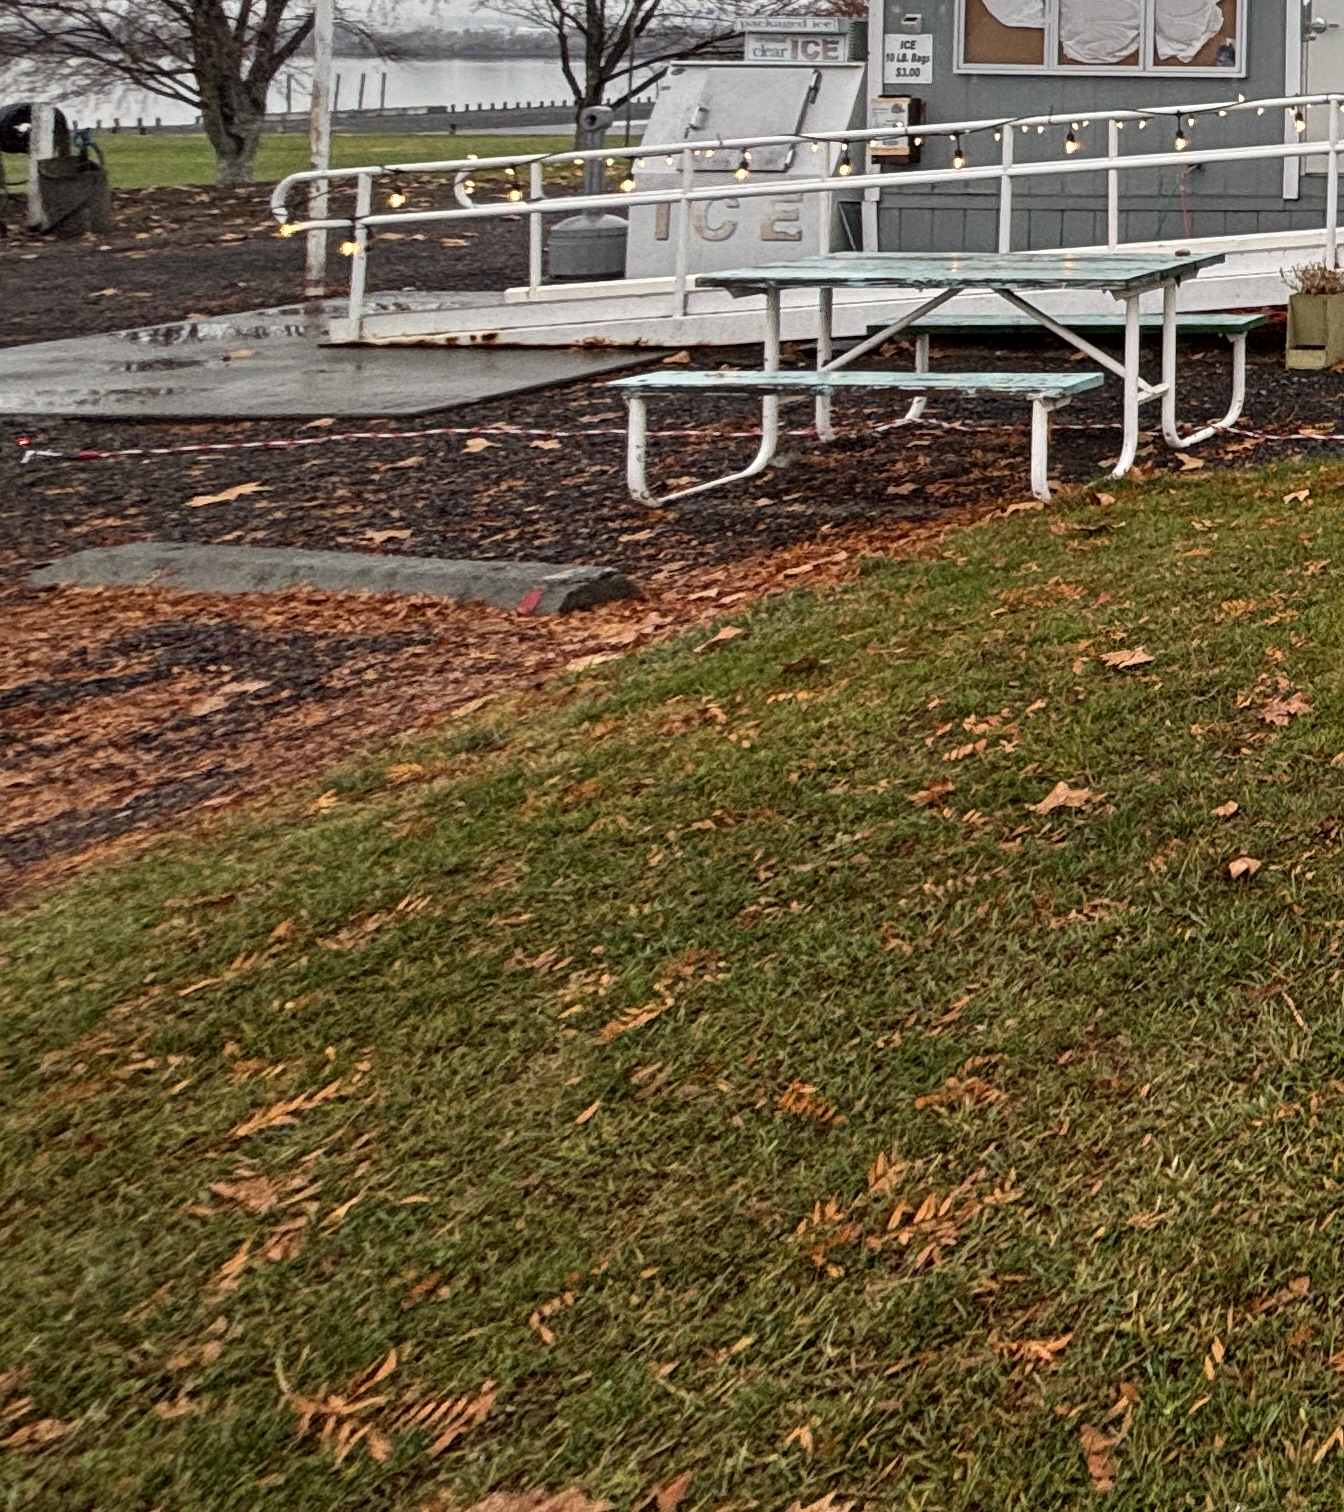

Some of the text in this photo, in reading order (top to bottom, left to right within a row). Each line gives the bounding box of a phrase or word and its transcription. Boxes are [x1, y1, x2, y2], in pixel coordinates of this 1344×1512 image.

[740, 18, 833, 29] packaged ice
[752, 38, 840, 60] clear ICE
[900, 40, 917, 50] ICE
[885, 52, 895, 63] 10
[911, 53, 931, 65] Bags
[895, 67, 921, 78] $3.00
[654, 193, 804, 242] ICE
